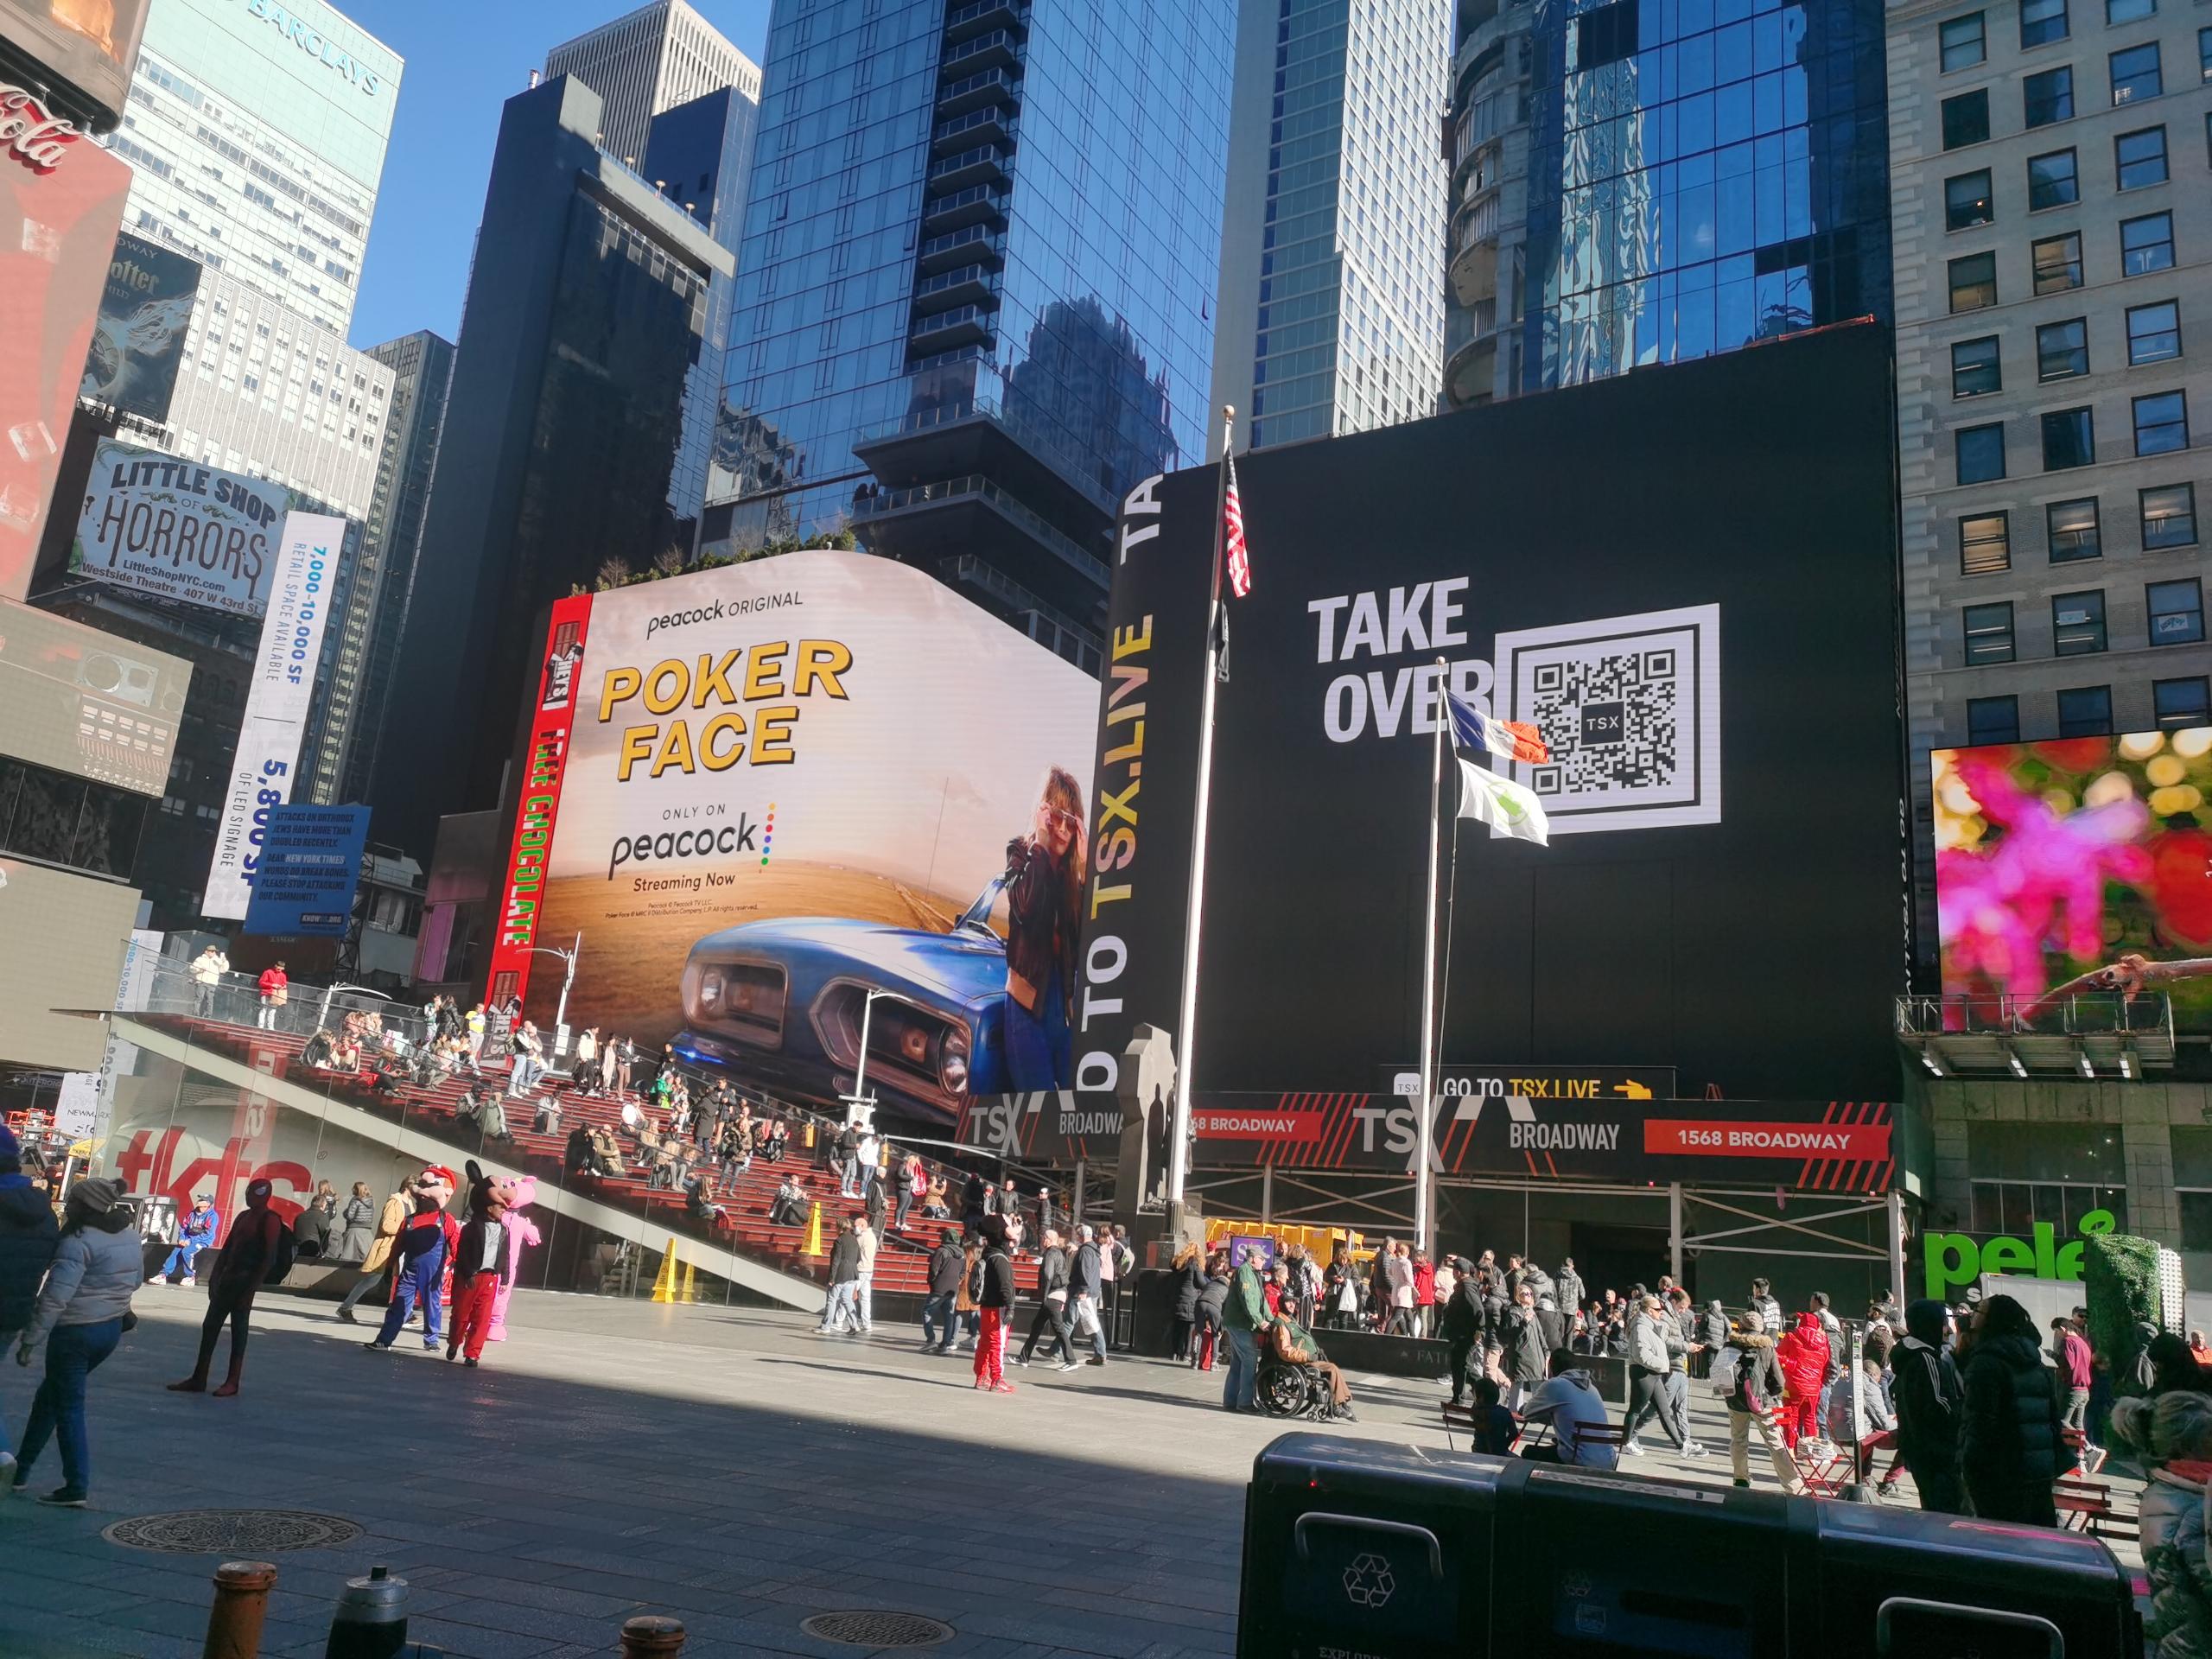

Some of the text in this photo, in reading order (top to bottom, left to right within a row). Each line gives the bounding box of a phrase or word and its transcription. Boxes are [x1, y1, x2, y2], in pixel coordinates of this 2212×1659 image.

[247, 0, 379, 96] BARCLAYS
[0, 82, 84, 168] ola
[110, 260, 159, 295] otter
[117, 237, 158, 258] DWAY
[111, 461, 276, 529] LITTLE SHOP
[181, 498, 200, 509] OF
[98, 494, 266, 600] HORRORS
[123, 559, 226, 593] LittleShopNYC.com
[82, 562, 132, 583] Westside
[136, 575, 177, 594] Theatre
[183, 587, 204, 600] 407
[206, 594, 219, 603] W
[219, 596, 244, 610] 43rd
[266, 543, 307, 682] RETAIL SPACE AVAILABLE
[286, 546, 327, 684] 7,000-10,000 SF
[646, 591, 804, 640] peacock ORIGINAL
[1307, 576, 1469, 664] TAKE
[598, 639, 853, 723] POKER
[1324, 658, 1495, 744] OVER
[617, 706, 799, 782] FACE
[1586, 715, 1620, 731] TSX
[530, 728, 565, 788] FREE
[1090, 614, 1154, 919] TSX.LIVE
[219, 772, 252, 868] OF LED SIGNAGE
[663, 803, 726, 820] ONLY ON
[285, 854, 302, 862] NEW
[302, 854, 321, 864] YORK
[502, 795, 554, 946] CHOCOLATE
[607, 812, 758, 881] peacock
[632, 873, 736, 893] Streaming Now
[118, 938, 138, 998] 7000-10,000
[1081, 935, 1128, 1033] TO
[1398, 1084, 1419, 1093] TSX
[1444, 1077, 1601, 1098] GO TO TSX.LIVE
[969, 1093, 1021, 1157] TSX
[1058, 1112, 1122, 1135] BROADWA
[1211, 1118, 1296, 1134] BROADWAY
[1353, 1095, 1446, 1173] TSX
[1510, 1123, 1620, 1151] BROADWAY
[1678, 1129, 1851, 1150] 1568 BROADWAY
[116, 1125, 314, 1249] tkts
